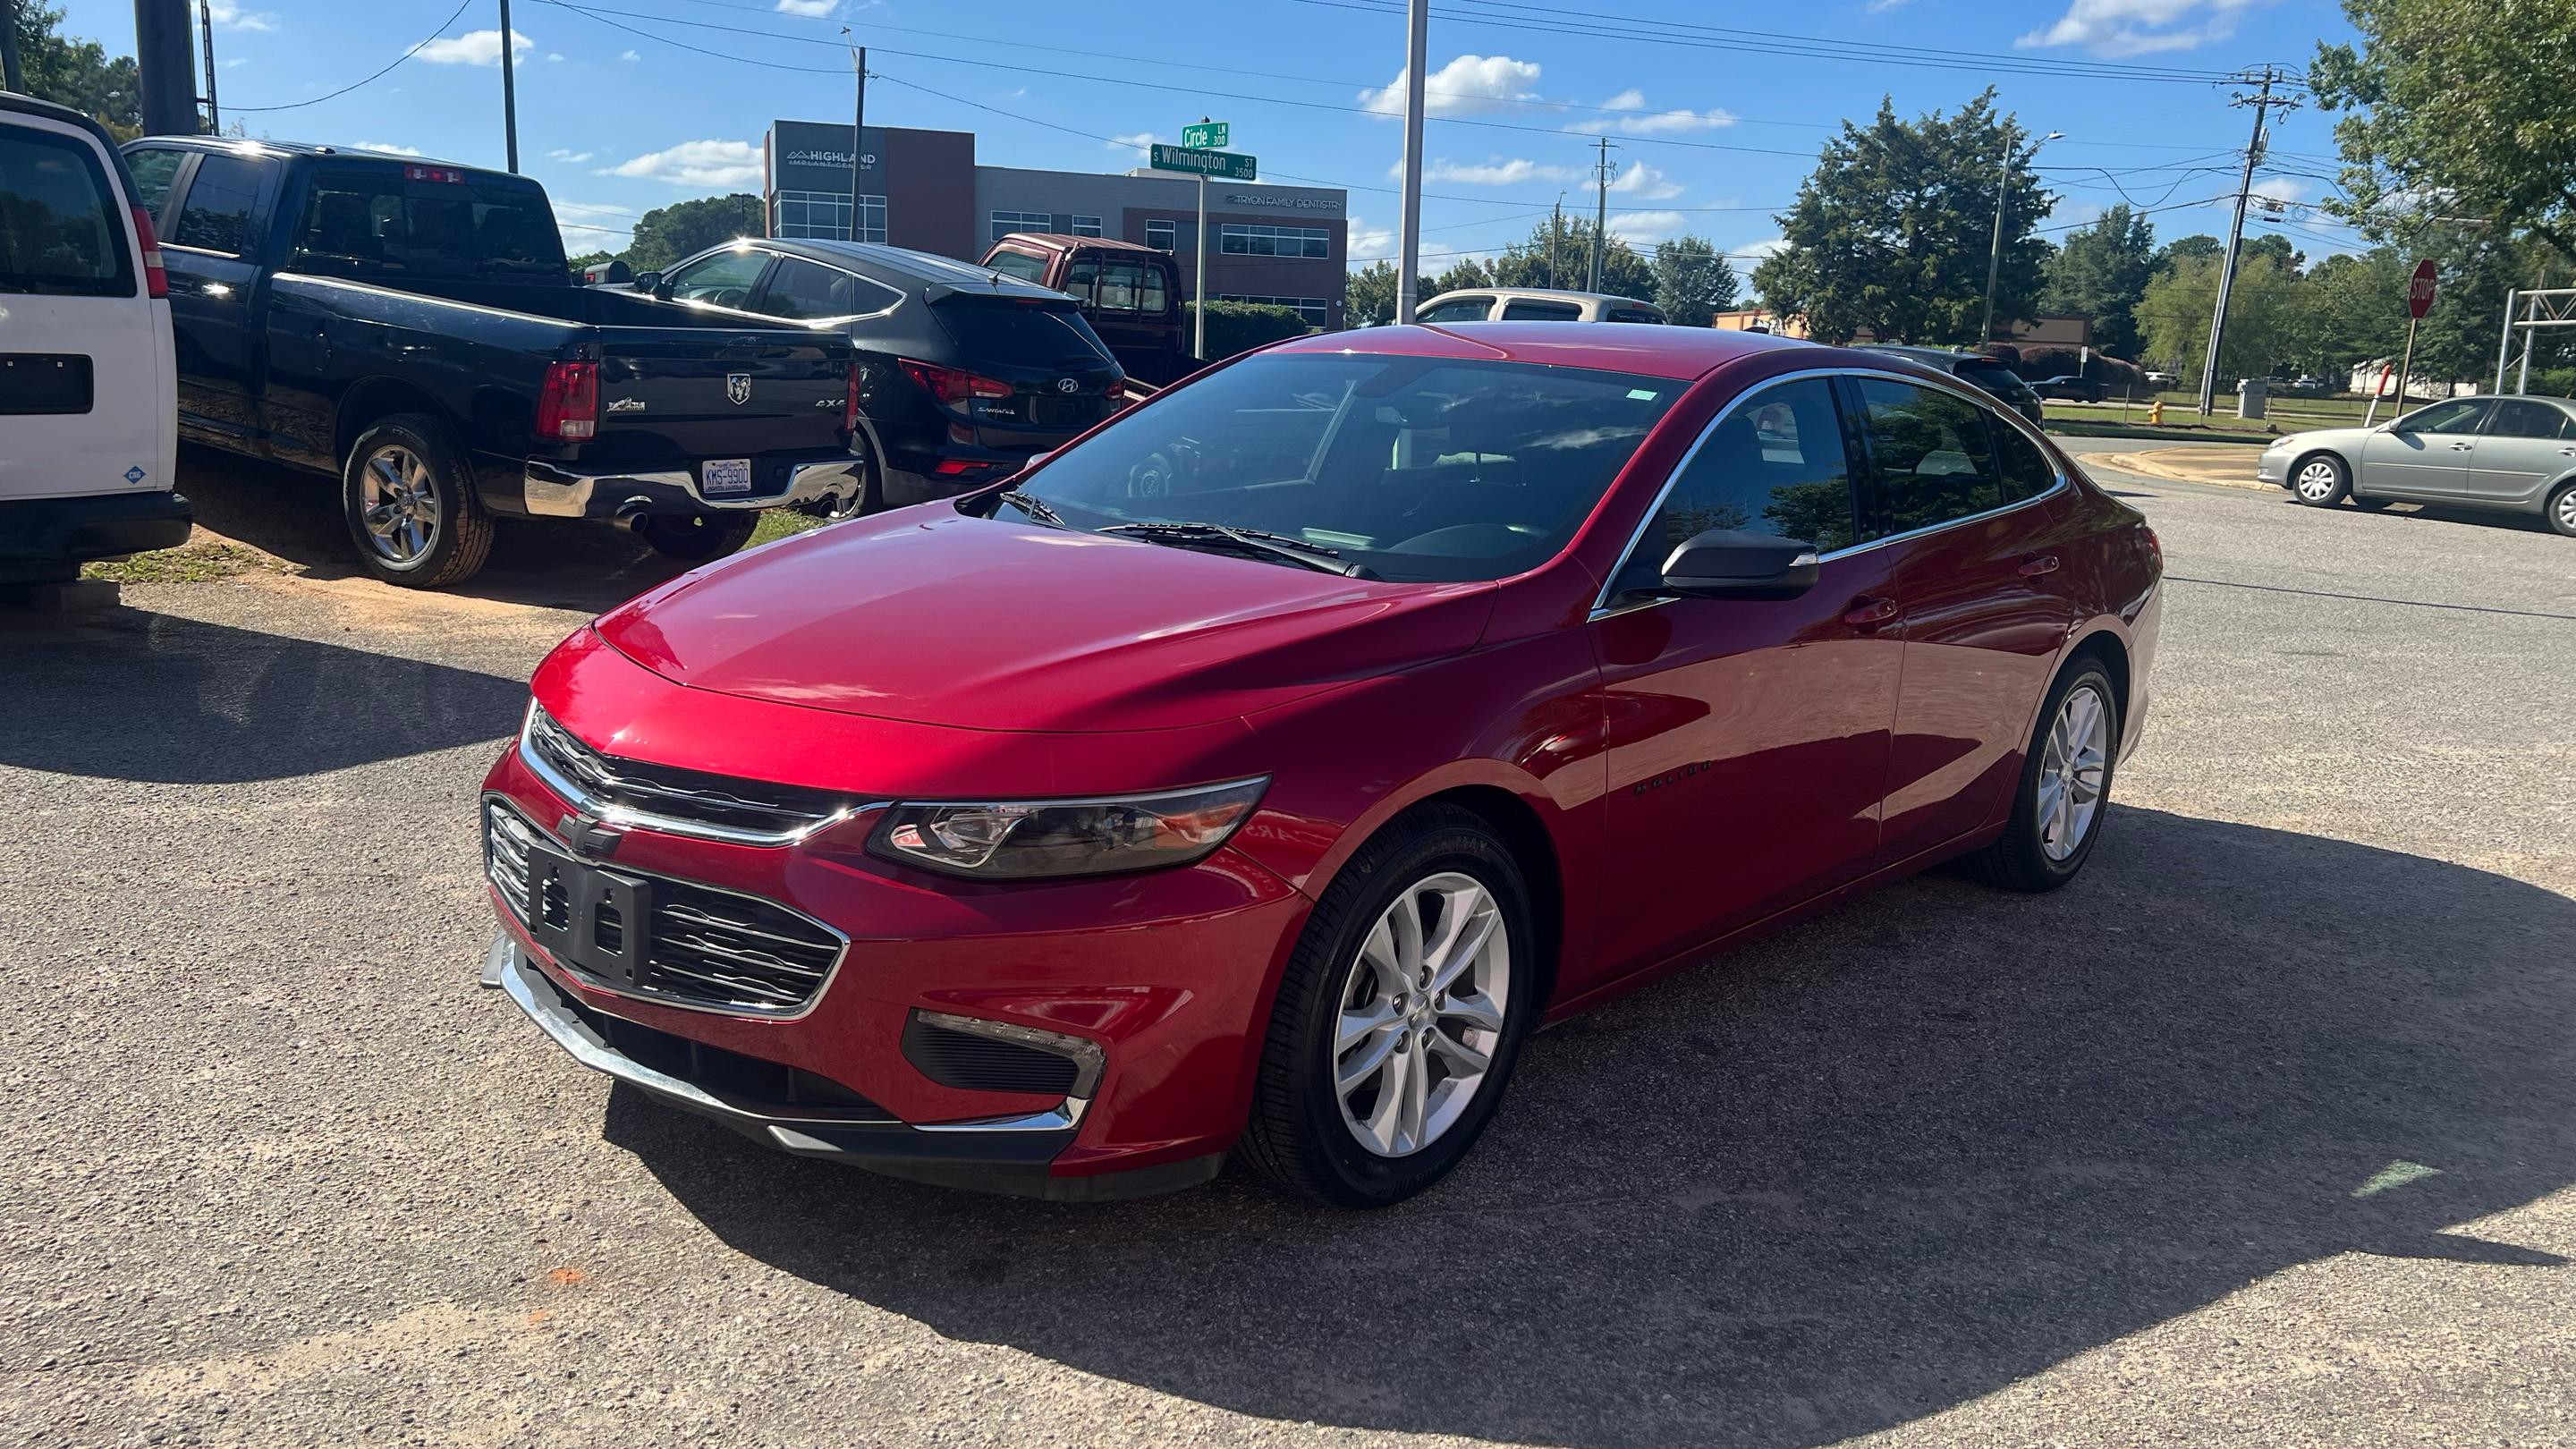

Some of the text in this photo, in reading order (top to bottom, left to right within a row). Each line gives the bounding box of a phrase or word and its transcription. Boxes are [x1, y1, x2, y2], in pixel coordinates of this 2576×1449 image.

[1184, 124, 1226, 148] Circle LN
[1213, 135, 1225, 146] 300
[789, 160, 832, 168] IMPLANT
[809, 150, 877, 165] HIGHLAND
[1153, 146, 1253, 174] S Wilmington ST
[1234, 167, 1253, 179] 3500
[1236, 195, 1343, 209] TRYON FAMILY DENTISTRY
[2411, 277, 2436, 301] STOP
[129, 470, 142, 479] CNG
[706, 468, 749, 486] KMS-9900
